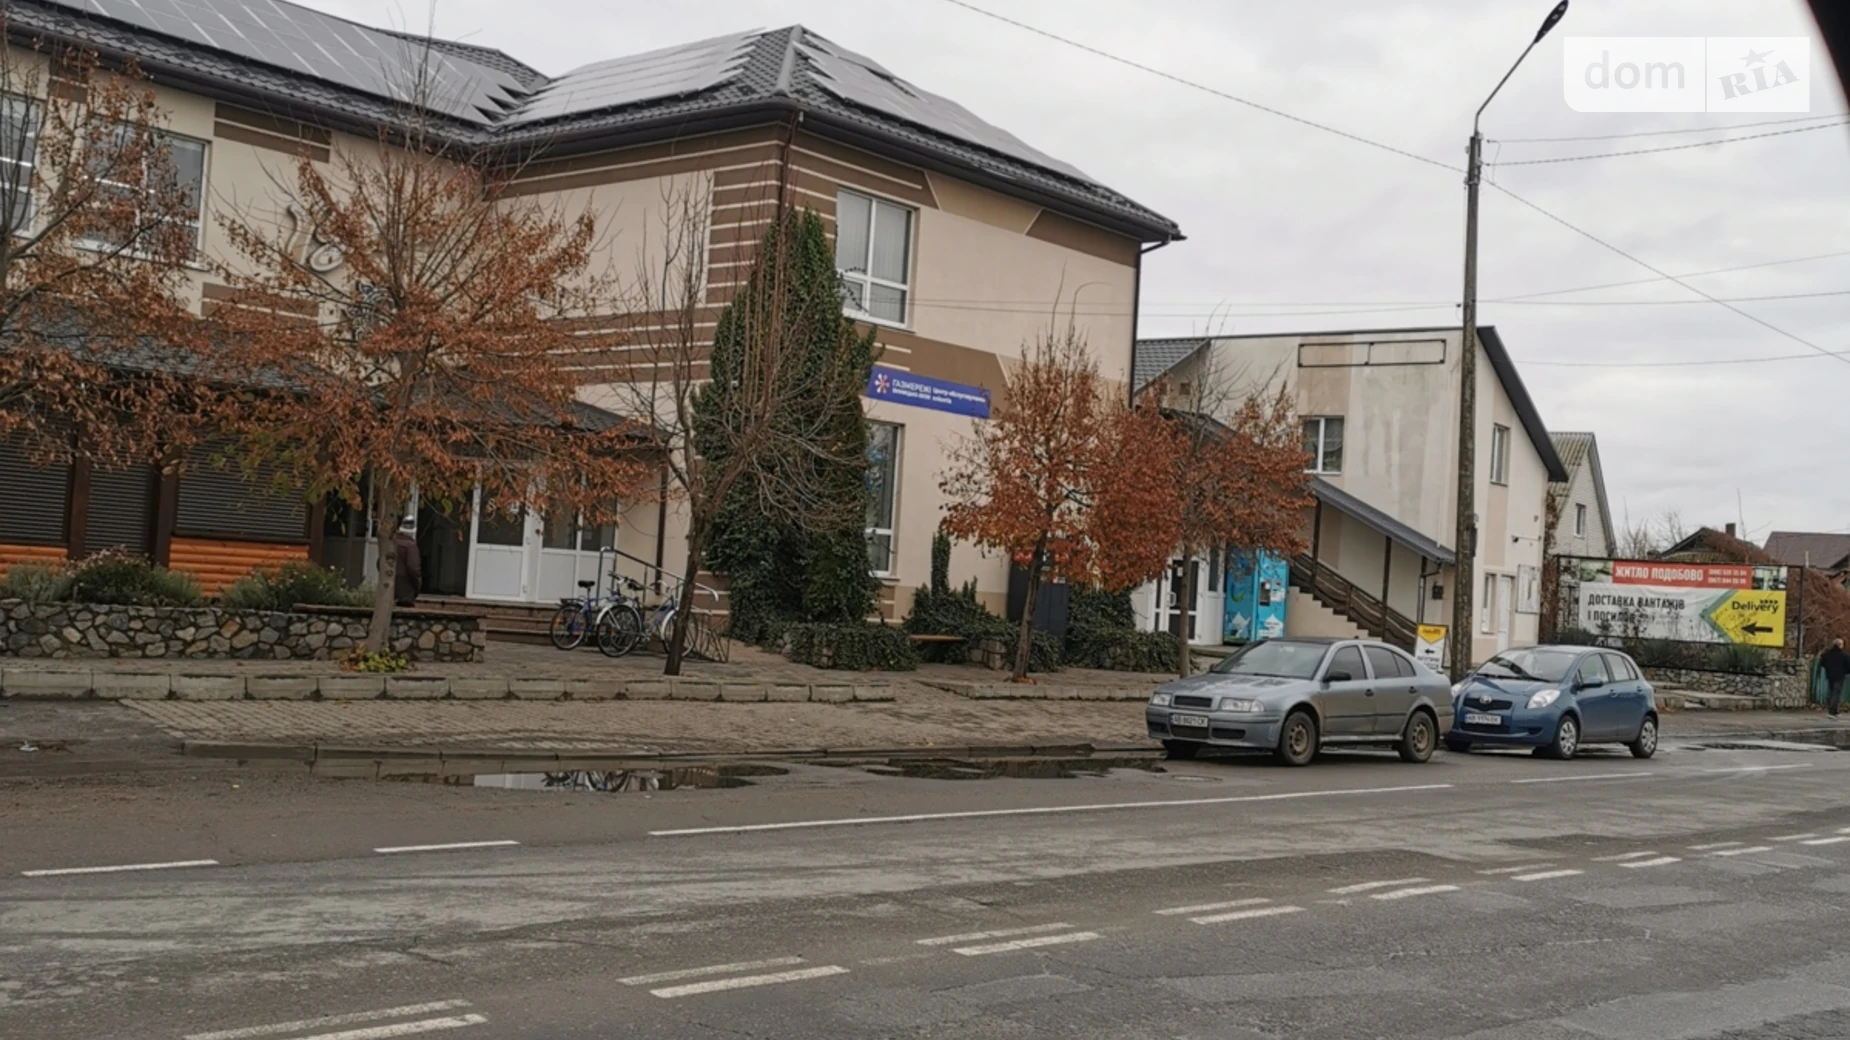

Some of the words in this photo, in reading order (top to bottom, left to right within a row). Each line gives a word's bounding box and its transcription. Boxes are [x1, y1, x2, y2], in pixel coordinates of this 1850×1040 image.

[1615, 566, 1649, 579] ЖИТЛО
[1651, 567, 1703, 582] ПОДОБОВО
[1588, 594, 1635, 607] ДОСТАВКА
[1637, 597, 1685, 610] ВАНТАЖІВ
[1732, 600, 1779, 614] Delivery
